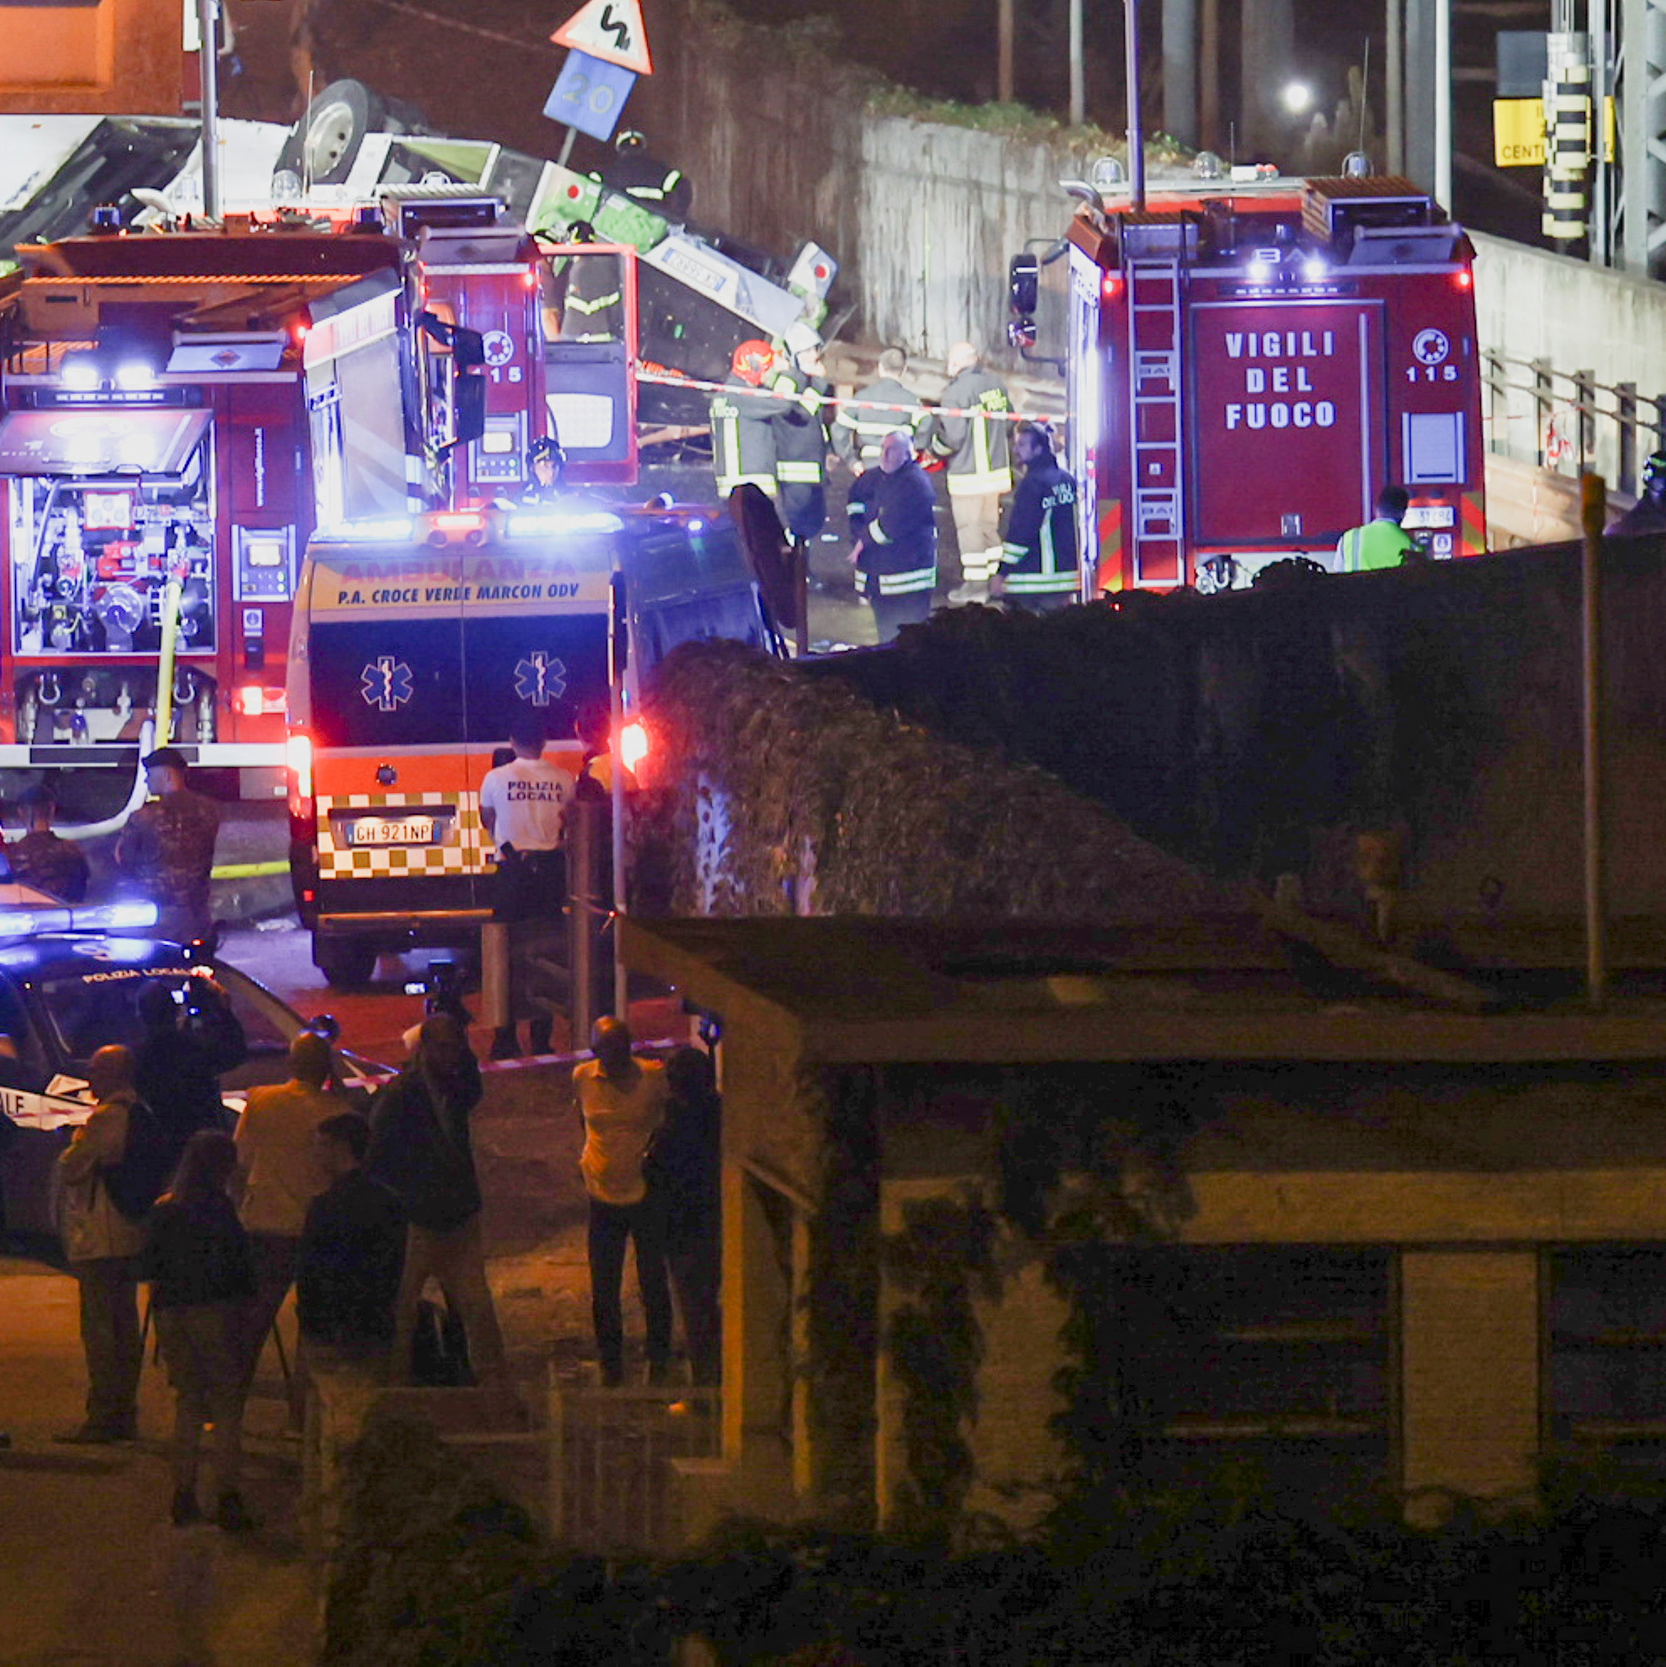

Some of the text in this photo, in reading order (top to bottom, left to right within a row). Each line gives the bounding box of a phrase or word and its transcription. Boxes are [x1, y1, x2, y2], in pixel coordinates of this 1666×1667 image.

[561, 71, 615, 114] 20
[1225, 330, 1334, 358] VIGILI
[1245, 366, 1313, 394] DEL
[1405, 366, 1458, 383] 115
[1225, 401, 1336, 430] FUOCO
[341, 557, 578, 584] AMBULANZA
[338, 582, 580, 605] P.A. CROCE VERDE MARCON ODV
[507, 780, 563, 791] POLIZIA
[81, 966, 194, 984] POLIZIA LOCAL
